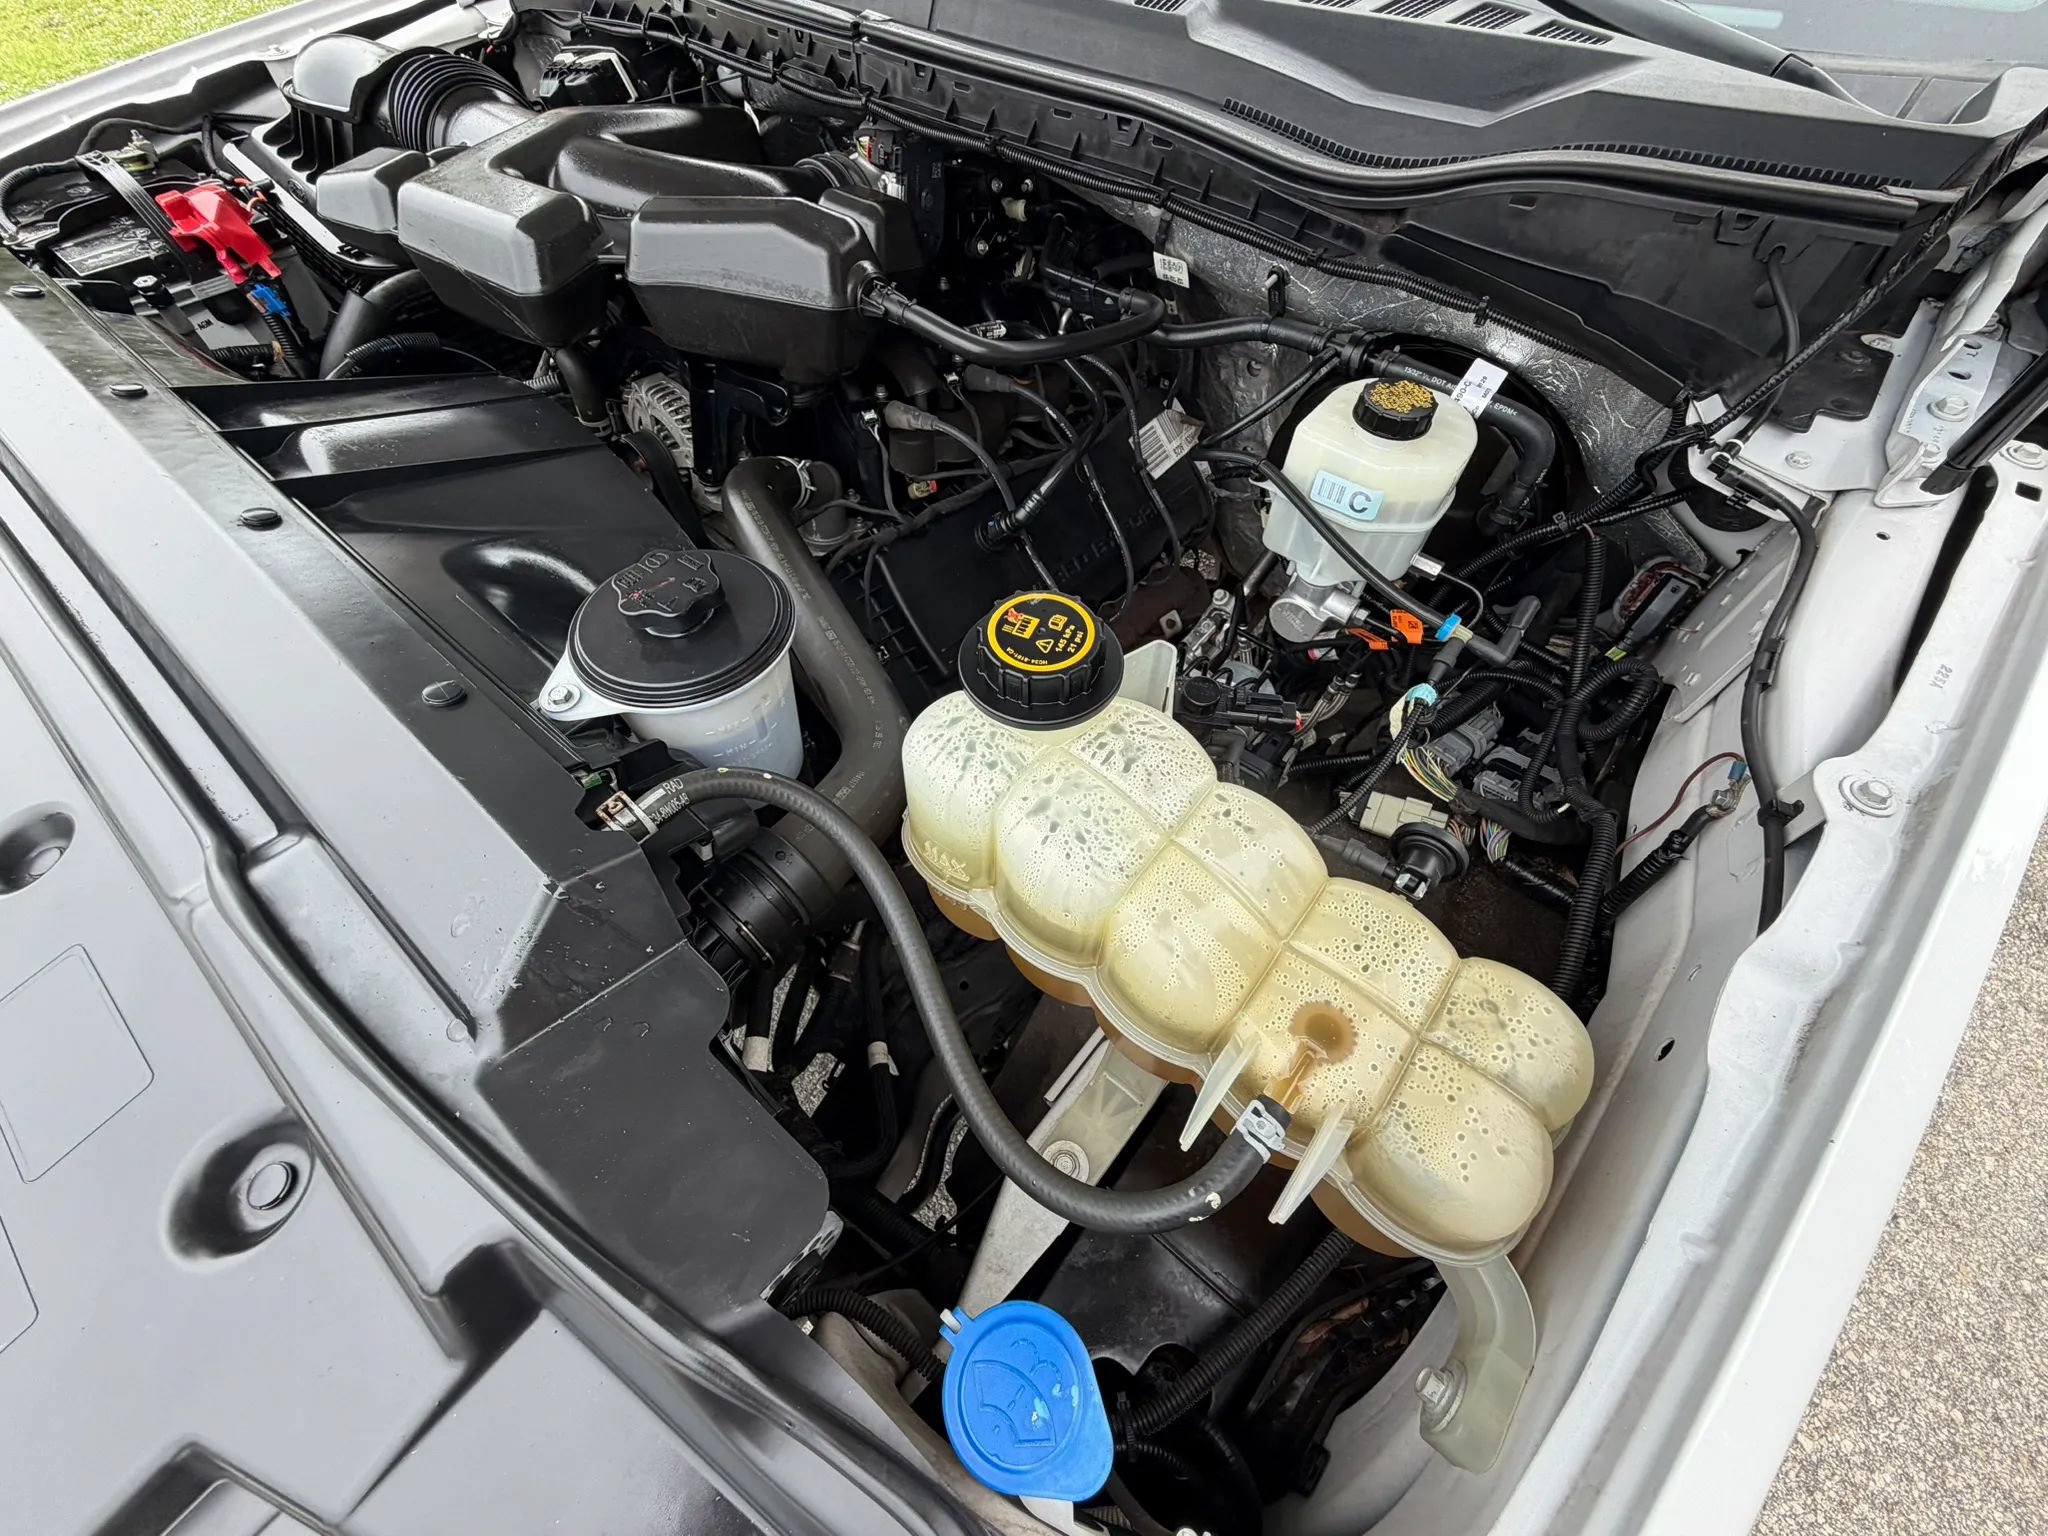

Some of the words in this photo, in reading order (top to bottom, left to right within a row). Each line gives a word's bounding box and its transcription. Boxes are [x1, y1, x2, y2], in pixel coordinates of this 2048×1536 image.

[1349, 491, 1372, 514] C
[1055, 638, 1067, 652] 145
[1064, 624, 1076, 639] kPa
[1067, 643, 1077, 653] 21
[1074, 631, 1084, 643] psi
[663, 778, 684, 795] RAD
